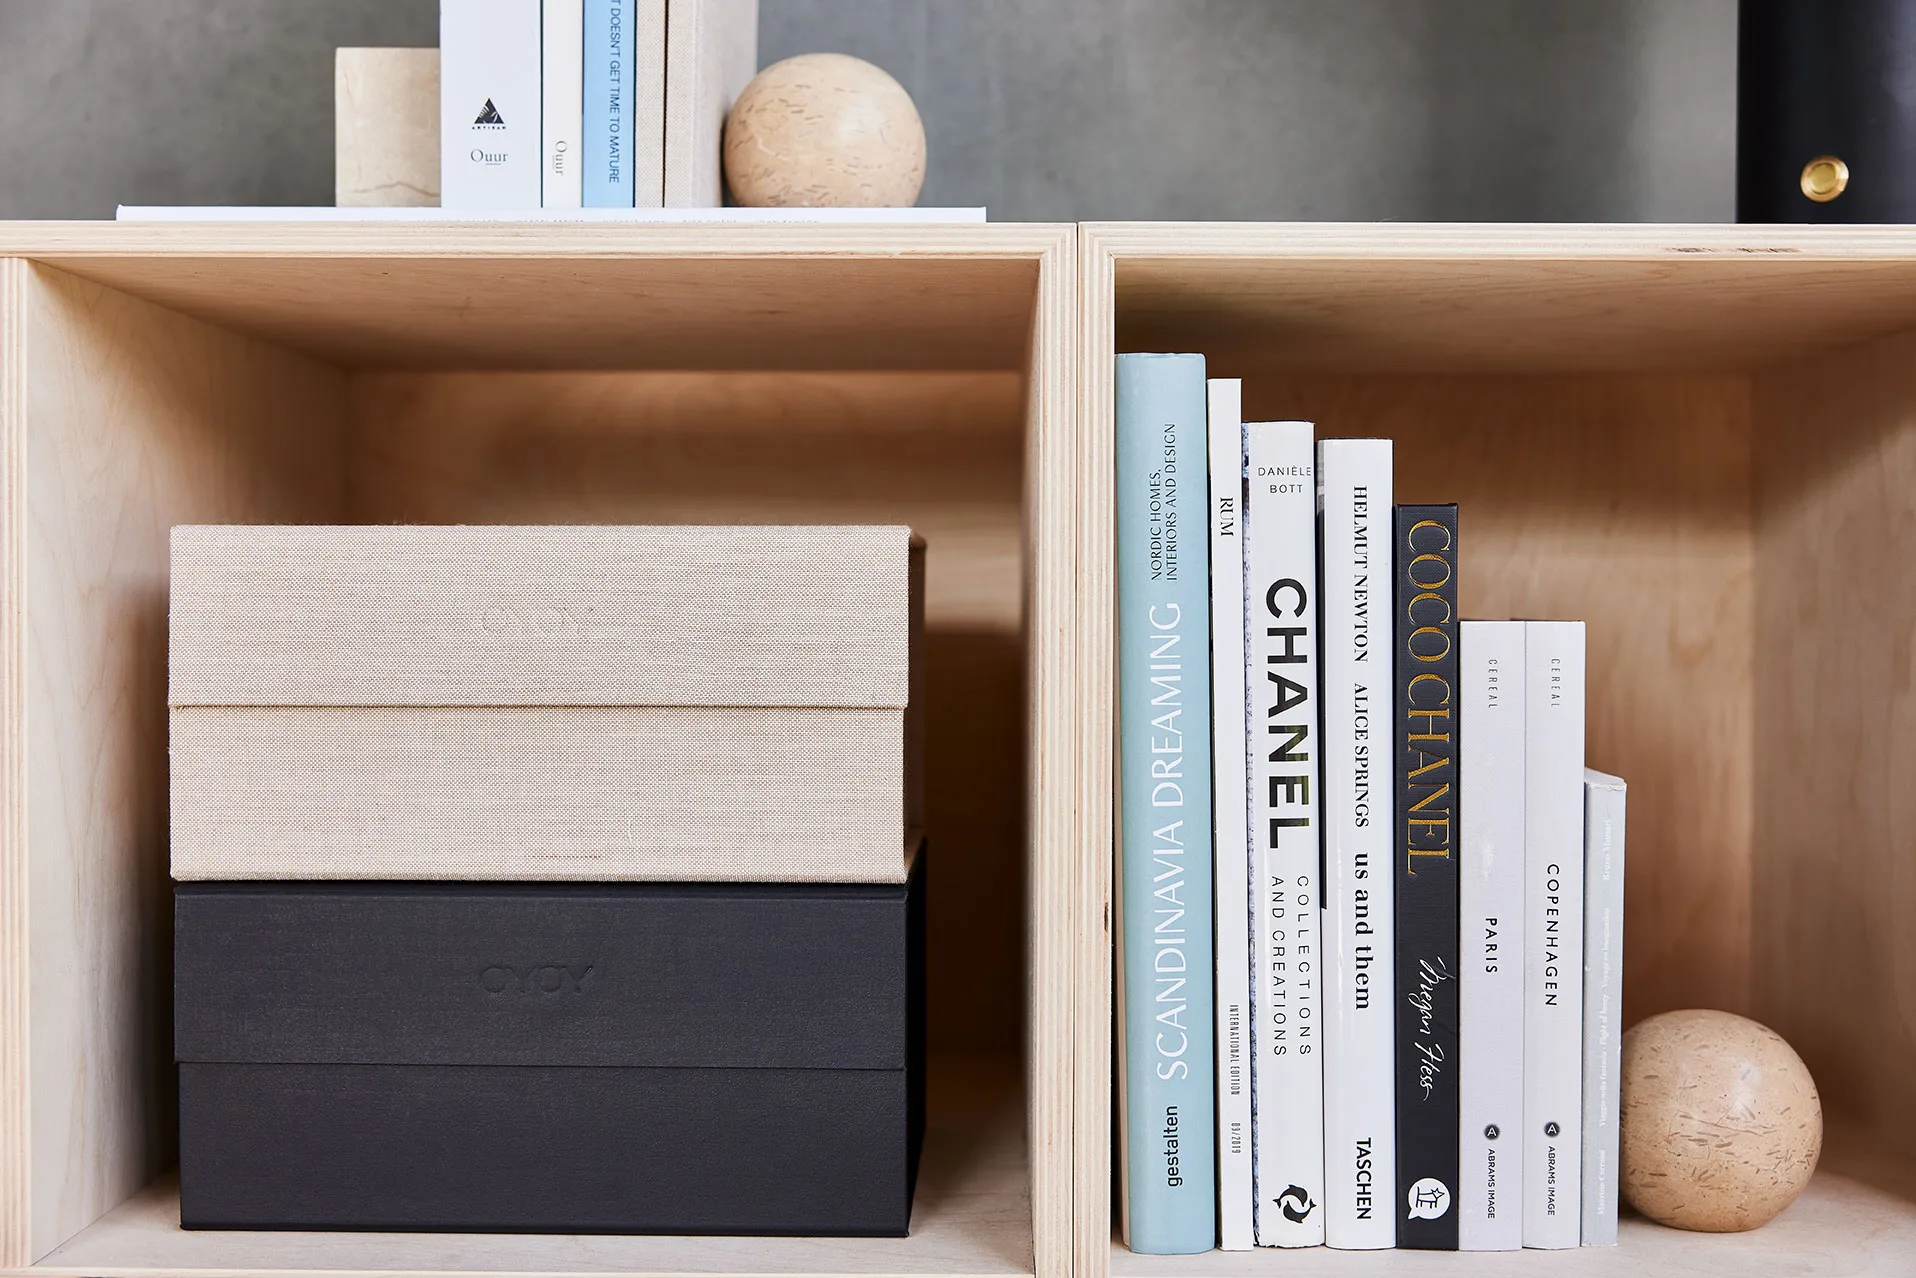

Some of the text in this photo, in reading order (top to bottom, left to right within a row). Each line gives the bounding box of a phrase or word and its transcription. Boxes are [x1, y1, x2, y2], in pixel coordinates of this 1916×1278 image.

[610, 8, 621, 57] DOESN'T
[609, 61, 621, 83] GET
[609, 87, 621, 113] TIME
[470, 149, 508, 165] Ouur
[554, 141, 568, 175] Ouur
[609, 117, 621, 133] TO
[609, 136, 620, 183] MATURE
[1164, 424, 1177, 580] INTERIORS AND DESIGN
[1257, 464, 1312, 477] DANIÈLE
[1269, 484, 1303, 494] BOTT
[1149, 468, 1163, 580] NORDIC HOMES,
[1220, 498, 1234, 537] RUM
[1353, 485, 1370, 828] HELMUT NEWTON ALICE SPRINGS
[1488, 659, 1498, 709] CEREAL
[1550, 658, 1561, 707] CEREAL
[1265, 577, 1309, 848] CHANEL
[1407, 519, 1452, 876] COCO CHANEL
[1149, 604, 1188, 1080] SCANDINAVIA DREAMING
[1271, 876, 1286, 1056] AND CREATIONS
[1296, 876, 1312, 1055] COLLECTIONS
[1354, 853, 1374, 1010] us and them
[1485, 917, 1498, 973] PARIS
[1546, 863, 1559, 1006] COPENHAGEN
[1229, 1004, 1240, 1095] INTERNATIONAL EDITION
[1408, 956, 1448, 1102] Megan Hess
[1166, 1106, 1181, 1186] gestalten
[1231, 1122, 1241, 1154] 09/2019
[1356, 1137, 1372, 1220] TASCHEN
[1487, 1147, 1497, 1219] ABRAMS IMAGE
[1547, 1145, 1557, 1216] ABRAMS IMAGE
